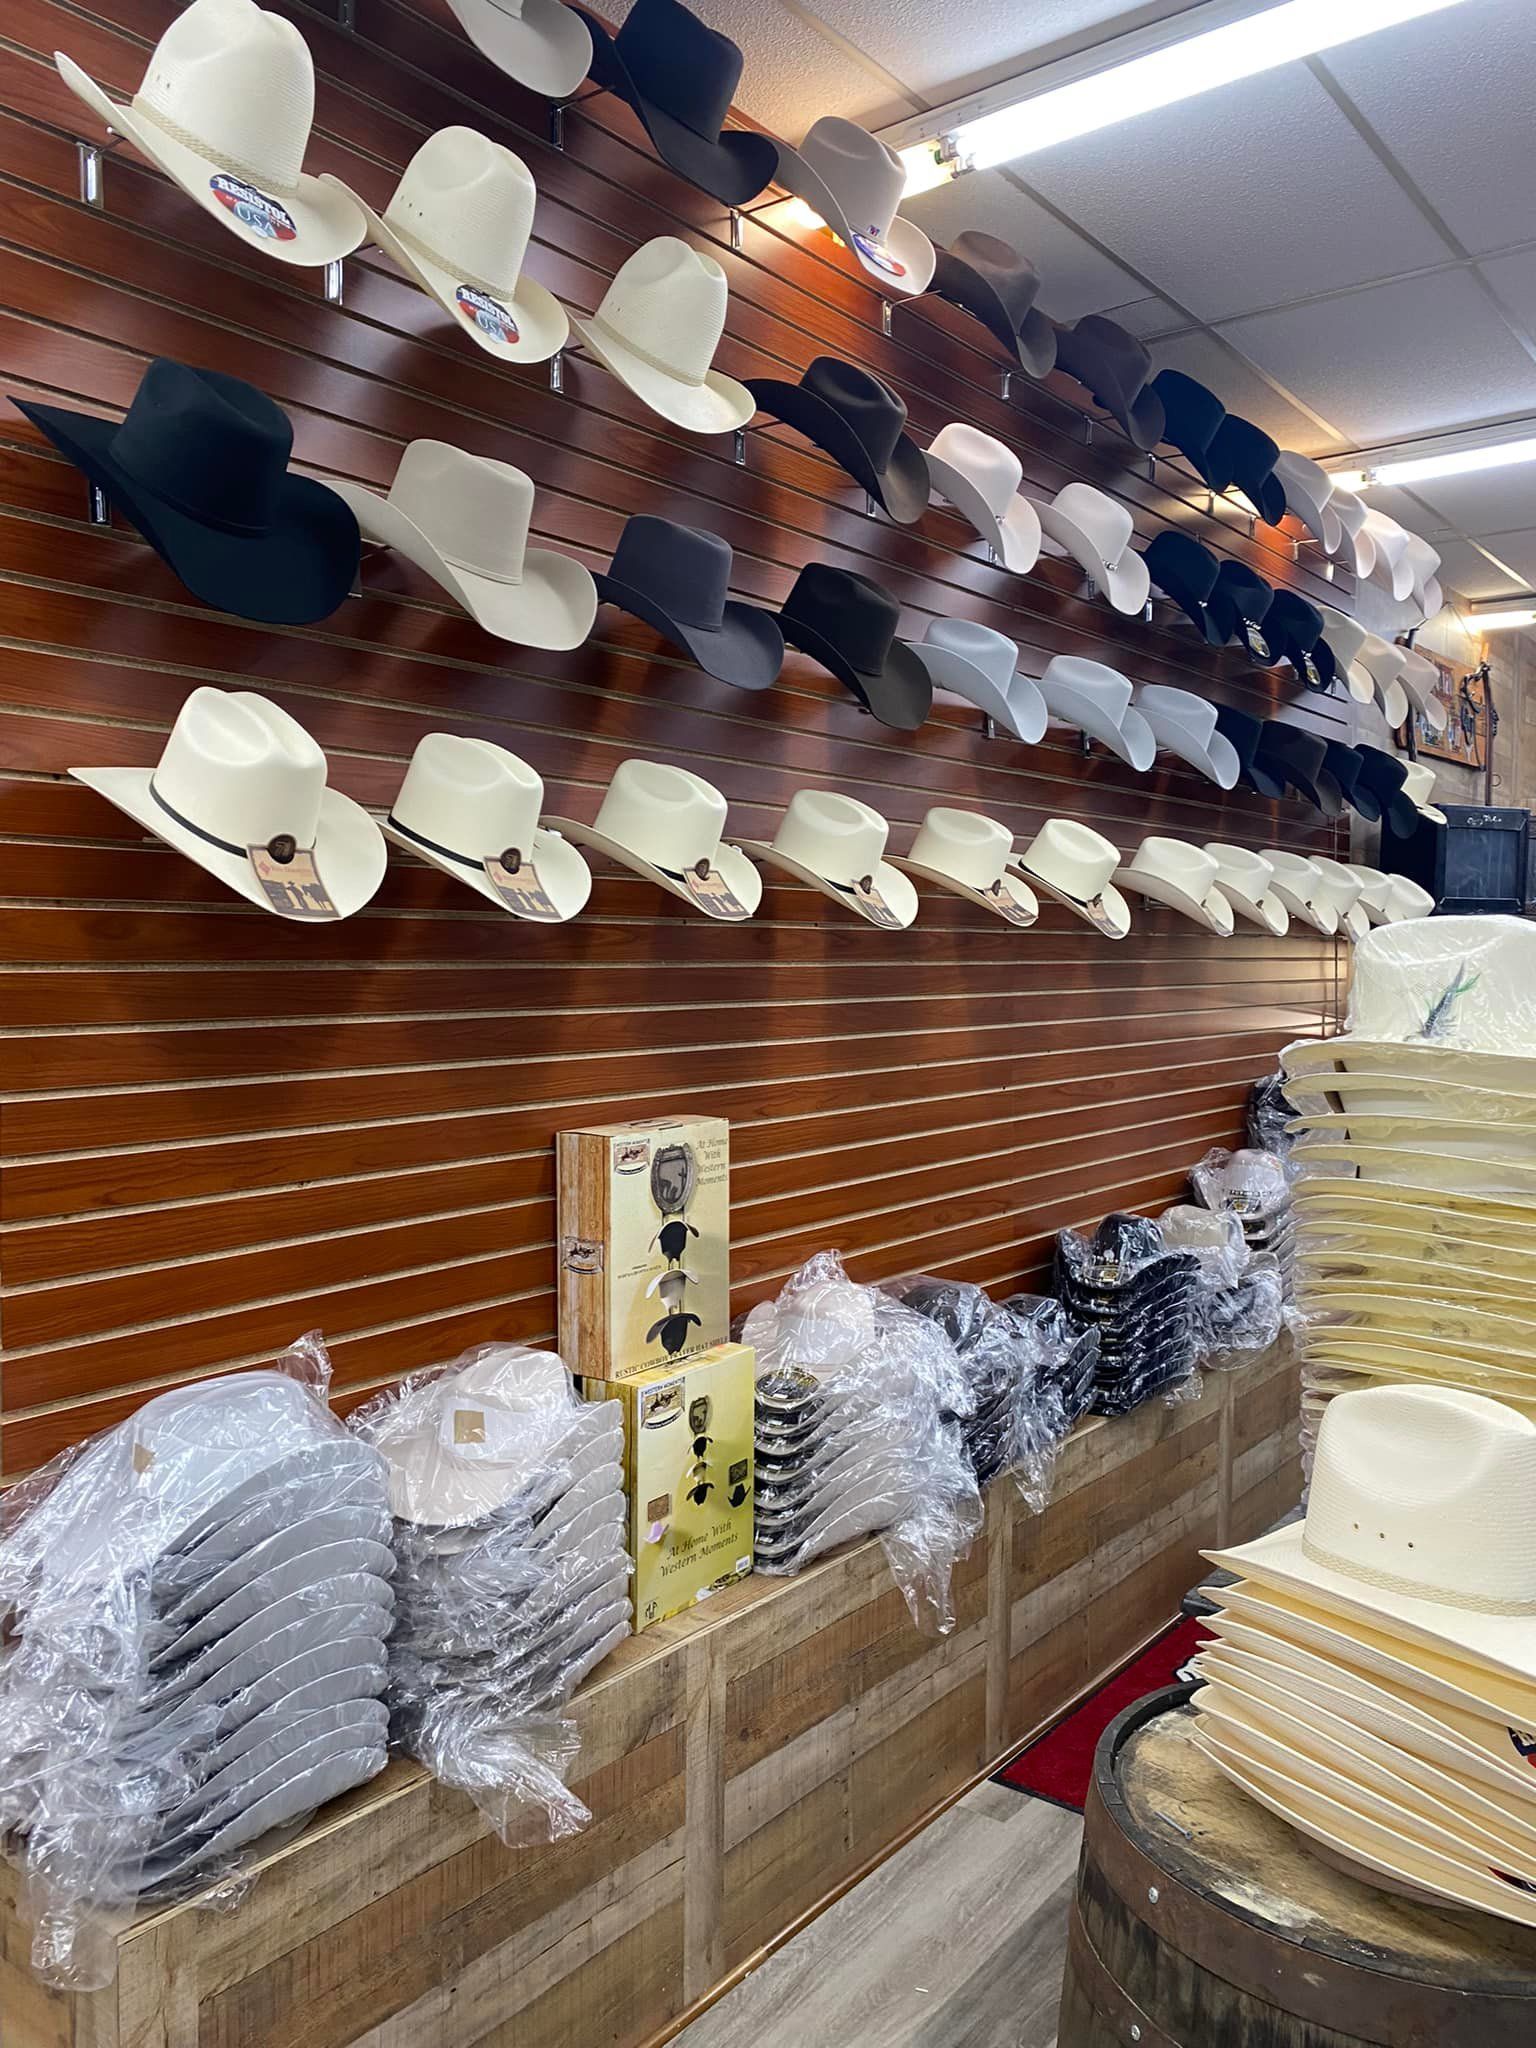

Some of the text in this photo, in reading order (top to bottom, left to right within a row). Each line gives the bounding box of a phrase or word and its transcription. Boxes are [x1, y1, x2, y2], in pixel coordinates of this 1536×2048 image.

[216, 176, 291, 226] RESISTOL
[237, 204, 278, 237] USA
[461, 287, 518, 329] RESISTOL
[478, 317, 506, 341] USA
[660, 1532, 738, 1577] Western Moments
[667, 1518, 732, 1560] At Home With
